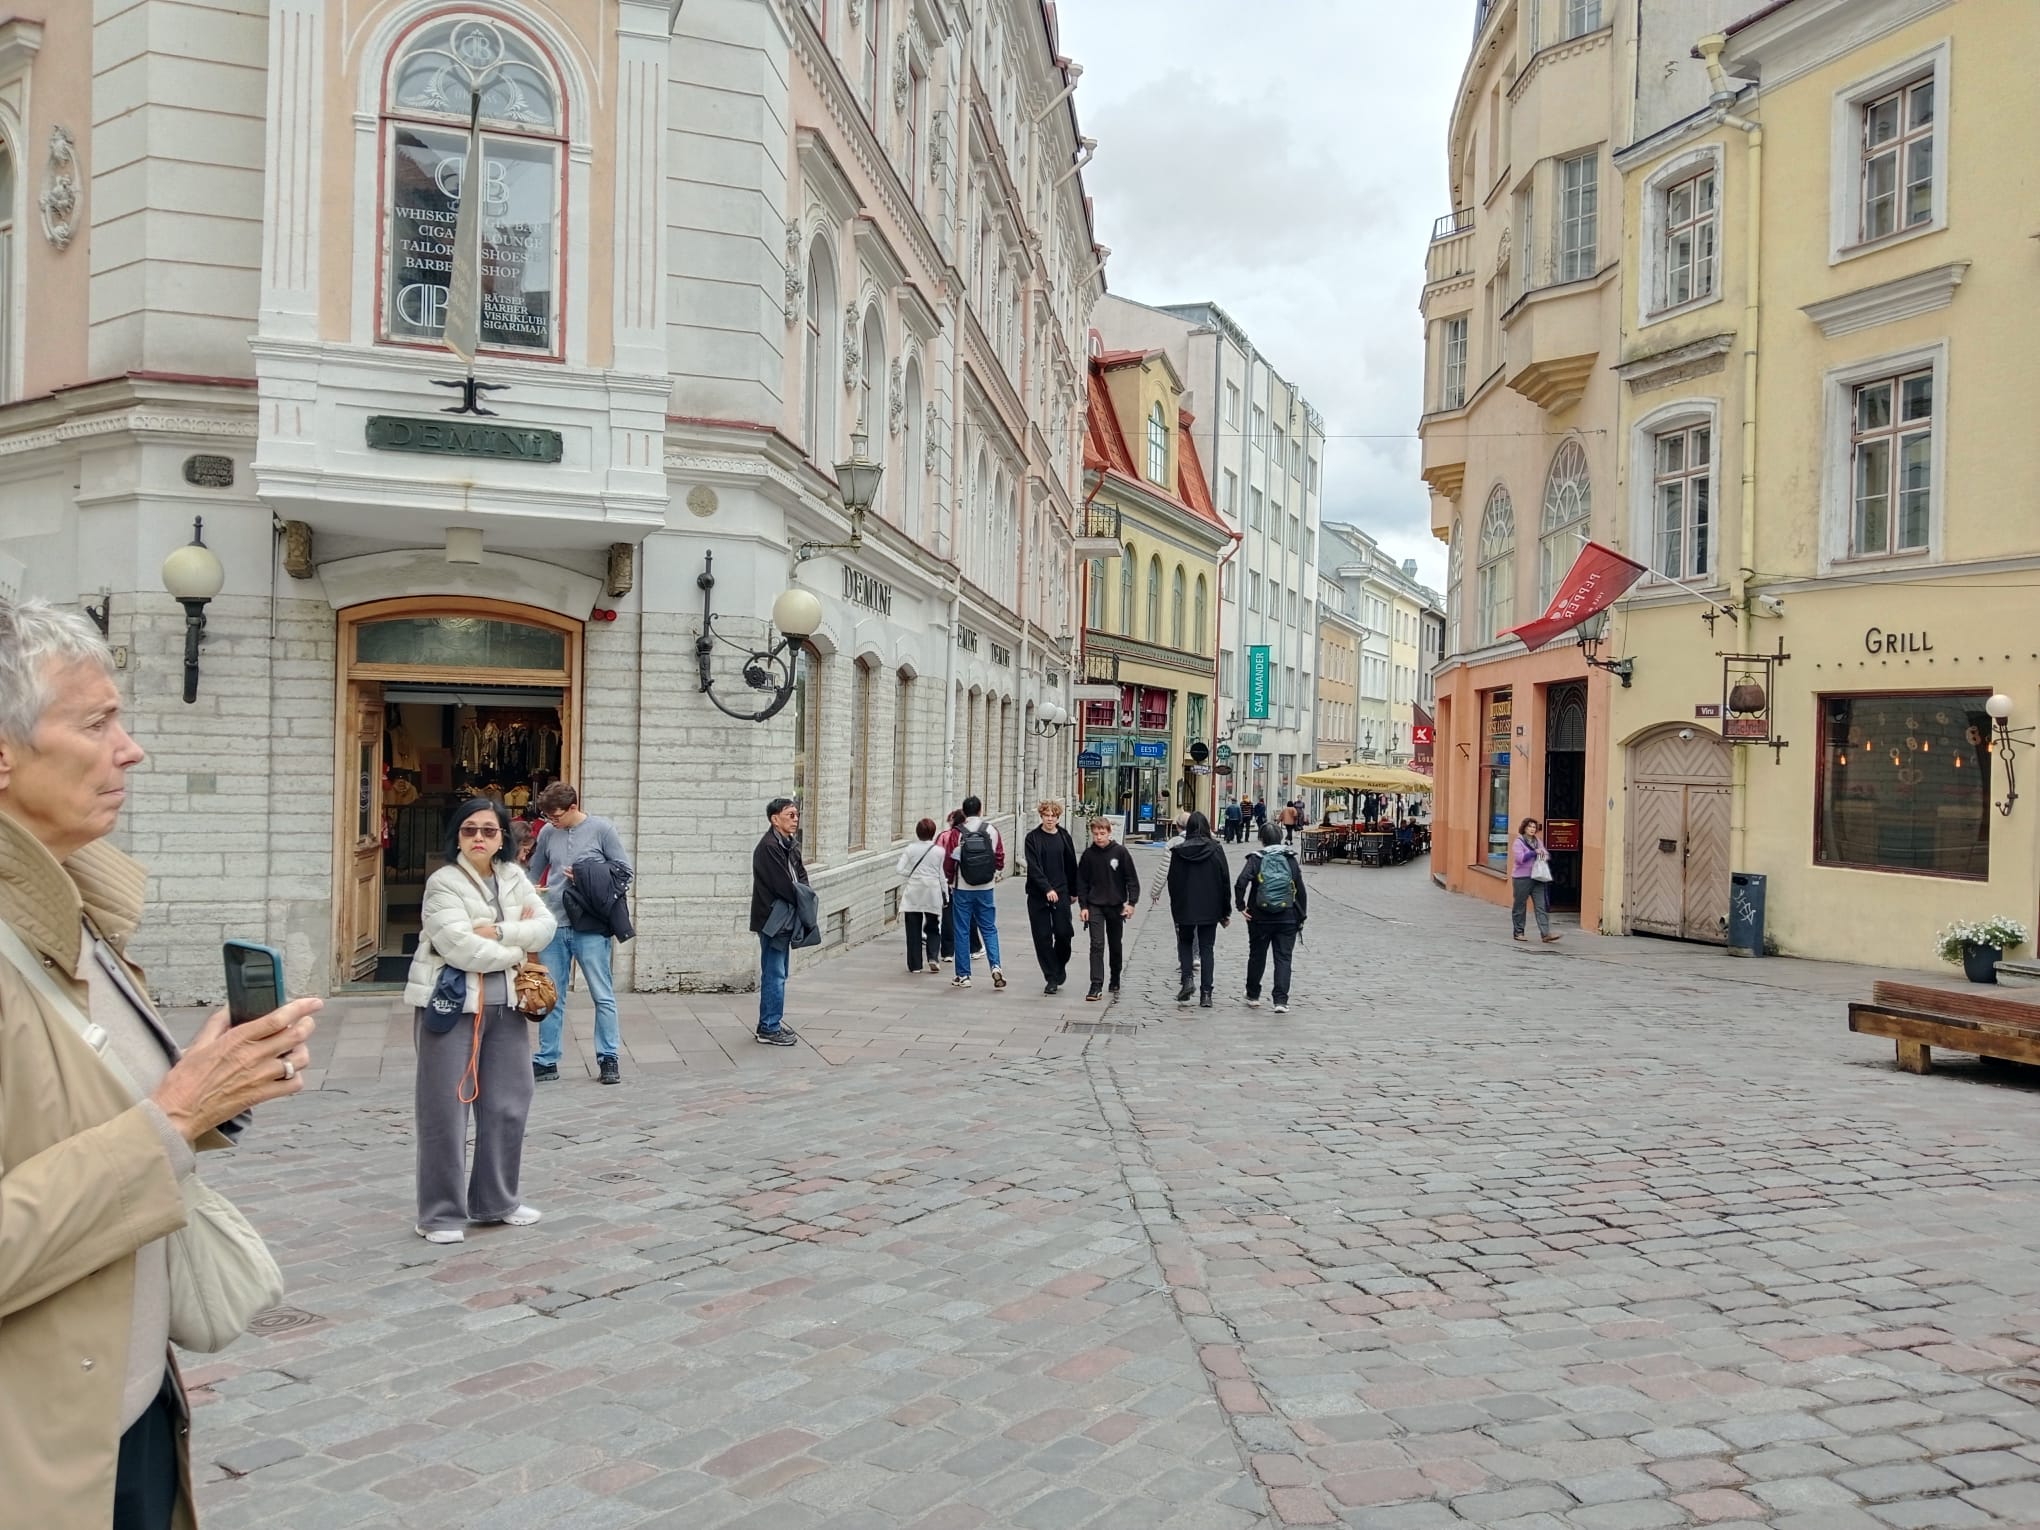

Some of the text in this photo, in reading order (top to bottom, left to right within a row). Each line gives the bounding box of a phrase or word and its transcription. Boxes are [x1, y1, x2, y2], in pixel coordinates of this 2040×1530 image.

[418, 225, 543, 249] CIGA LOUNGE
[481, 249, 528, 263] SHOES
[405, 257, 520, 279] BARBE SHOP
[484, 303, 529, 315] BARBER
[484, 311, 547, 325] VISKIKLUBI
[483, 320, 548, 335] SIGARIMAJA
[1254, 652, 1265, 713] SALAMANDER
[1701, 707, 1714, 715] Viru
